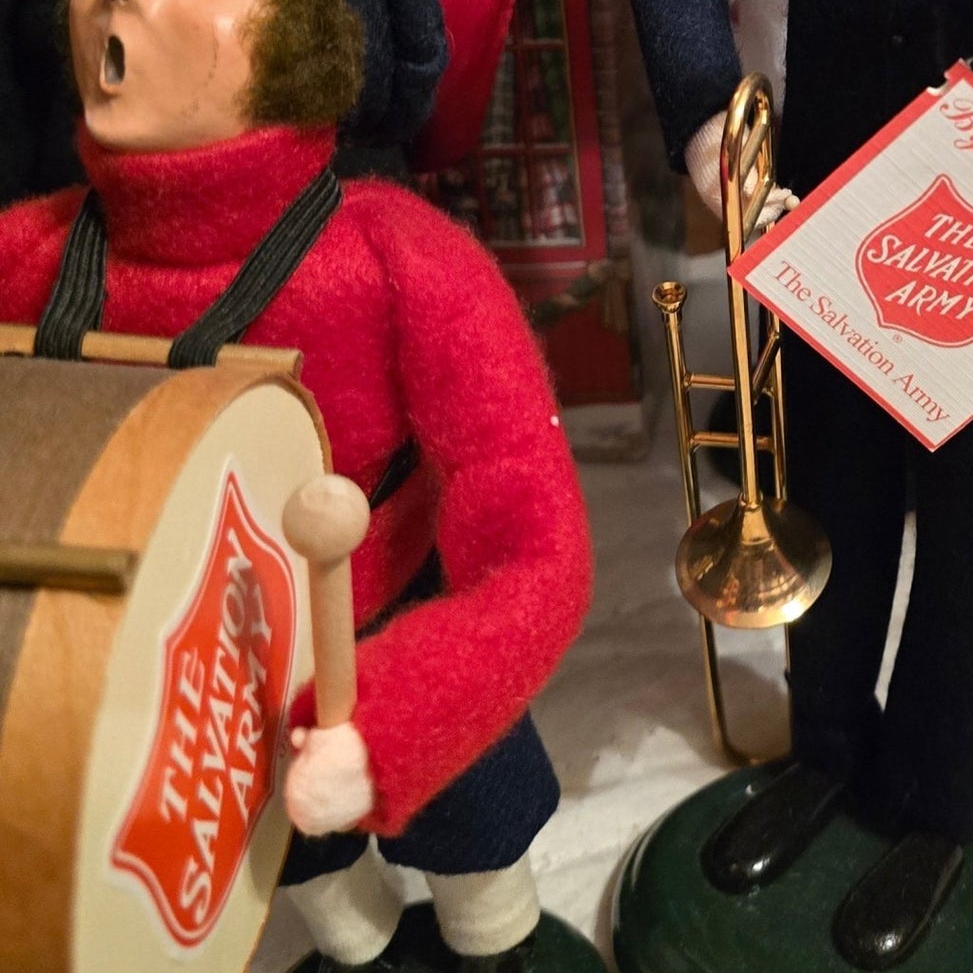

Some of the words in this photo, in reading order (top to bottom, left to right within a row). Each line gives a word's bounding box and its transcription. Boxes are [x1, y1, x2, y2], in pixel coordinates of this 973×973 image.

[774, 260, 812, 302] The
[809, 294, 896, 376] Salvation
[893, 373, 950, 422] Army
[160, 645, 205, 824] THE
[180, 527, 253, 927] SALVATION
[229, 582, 273, 829] ARMY
